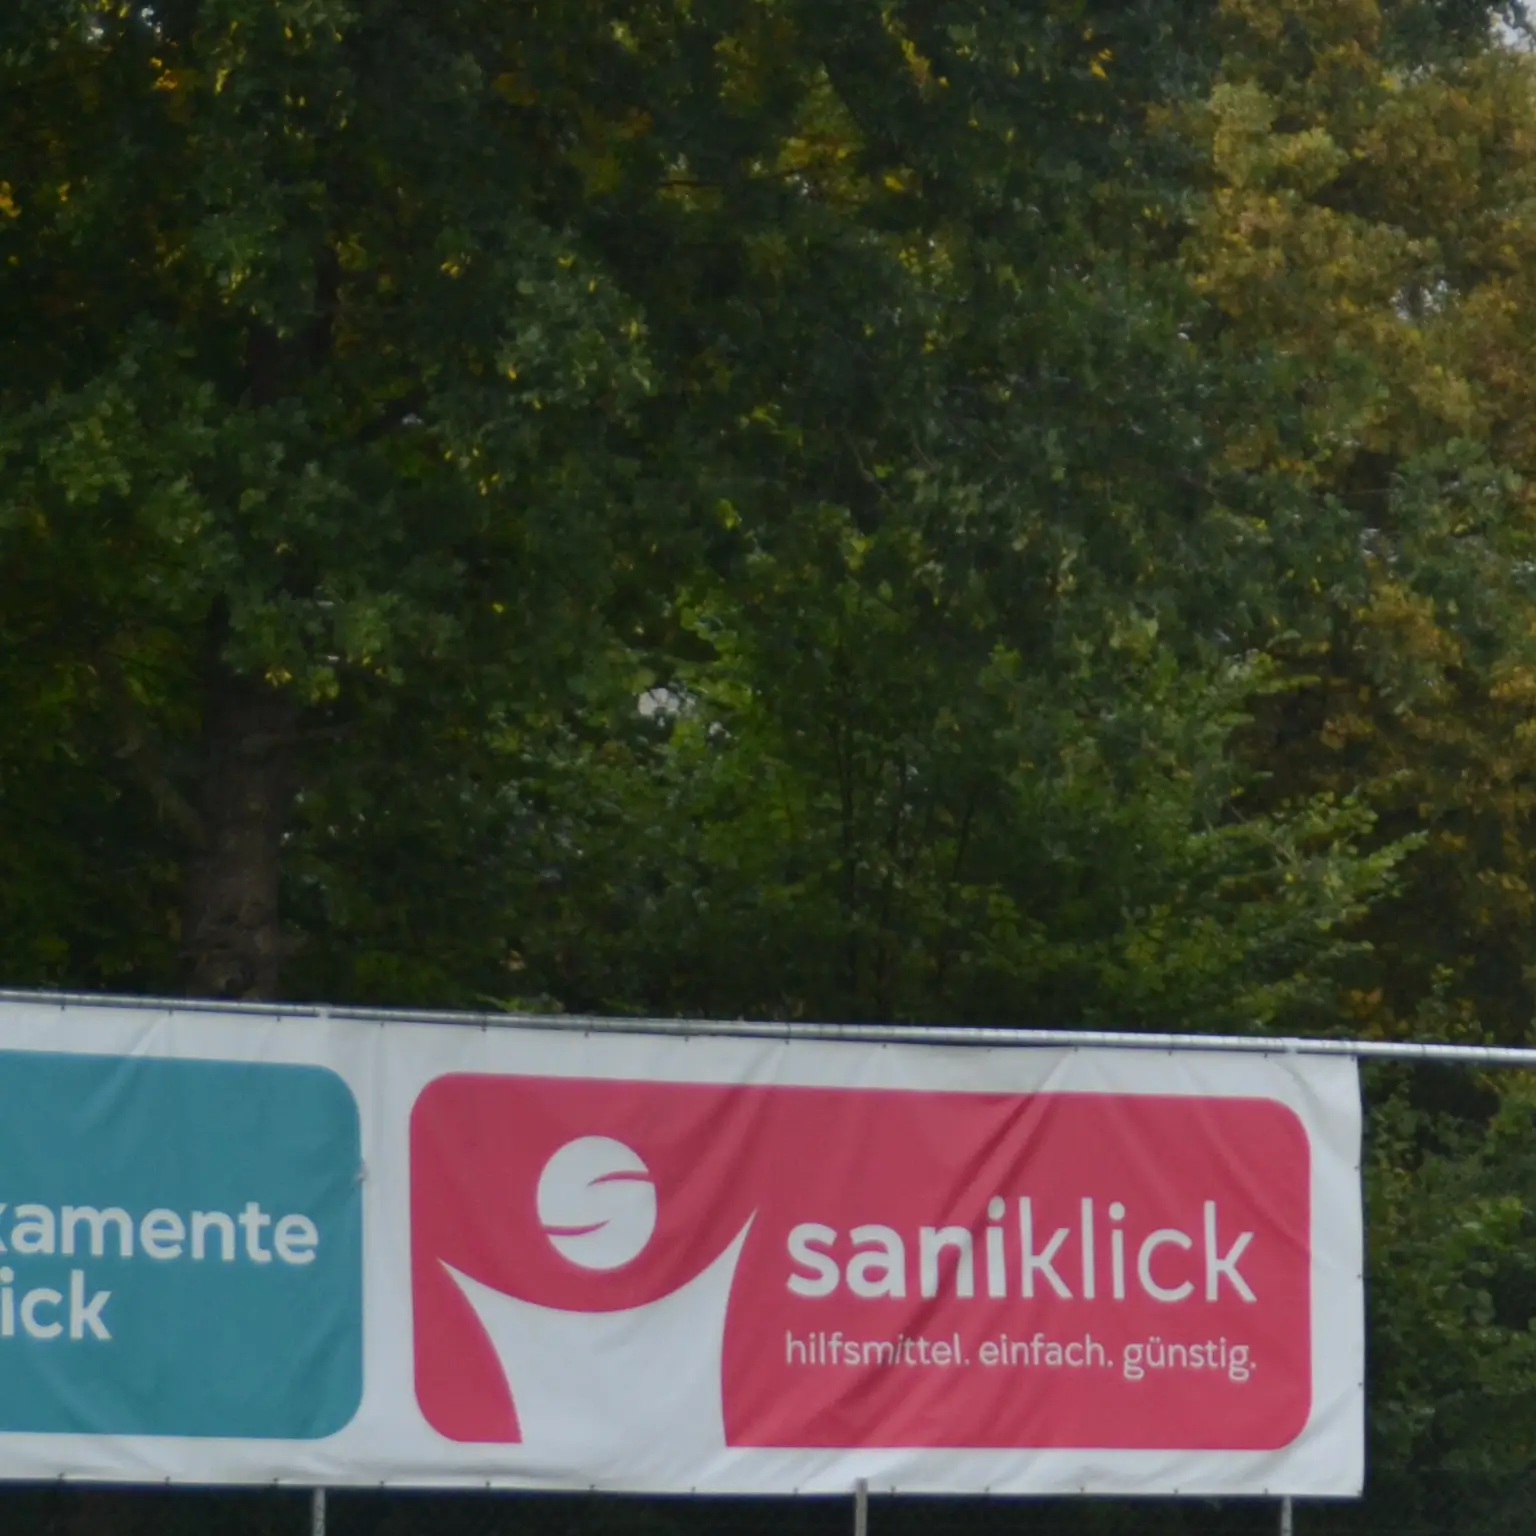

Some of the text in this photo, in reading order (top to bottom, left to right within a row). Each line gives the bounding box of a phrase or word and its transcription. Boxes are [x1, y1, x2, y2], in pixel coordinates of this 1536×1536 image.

[0, 1200, 319, 1265] amente
[786, 1195, 1258, 1303] saniklick
[785, 1329, 1258, 1382] hilfsmittel. einfach. günstig.
